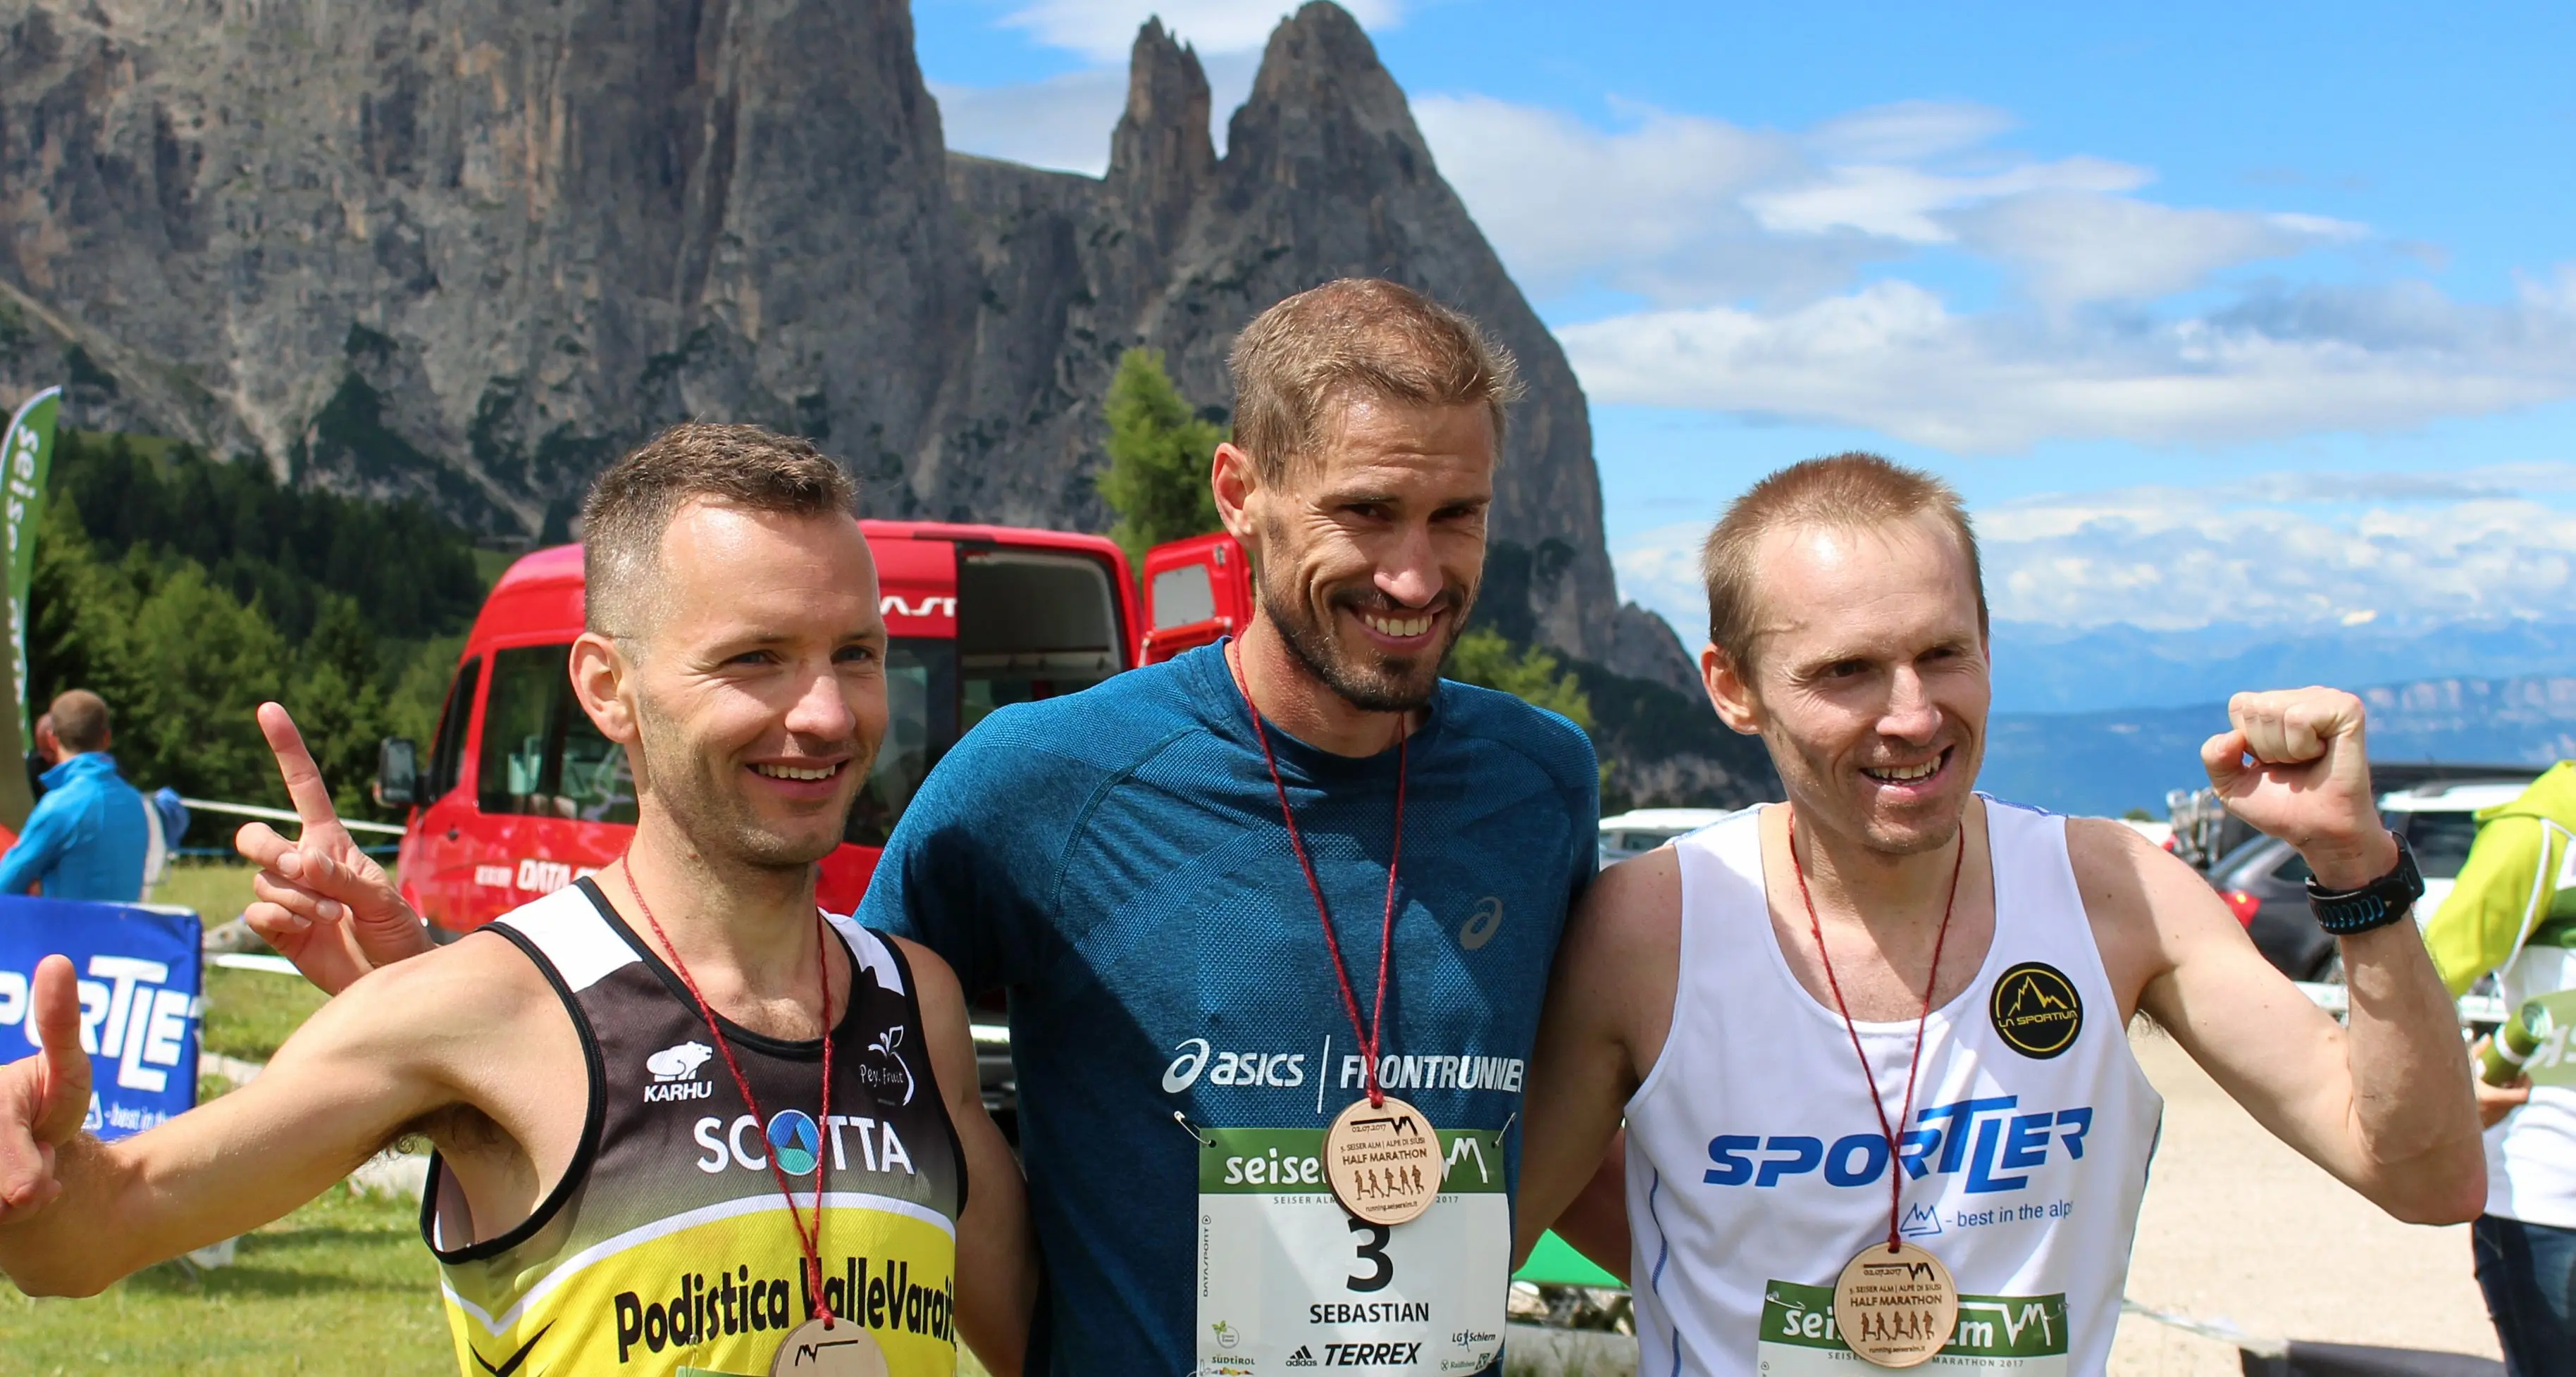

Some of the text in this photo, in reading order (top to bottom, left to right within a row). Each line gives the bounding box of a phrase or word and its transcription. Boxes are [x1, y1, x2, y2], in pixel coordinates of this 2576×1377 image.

[0, 955, 203, 1092] PRTLE
[1998, 1010, 2078, 1028] LA SPORTIVA
[1340, 1055, 1524, 1093] FRONTRUNNER
[644, 1080, 712, 1102] KARHU
[694, 1109, 915, 1176] SCOTTA
[1346, 1142, 1367, 1152] SEISER
[1368, 1141, 1381, 1149] ALM
[1386, 1139, 1401, 1147] ALPE
[1702, 1095, 2093, 1194] SPORTLER
[1342, 1148, 1428, 1165] HALF MARATHON
[1957, 1209, 1994, 1227] best
[1999, 1206, 2013, 1223] in
[2019, 1203, 2043, 1221] the
[1346, 1216, 1394, 1292] 3
[614, 1257, 957, 1364] Podistica ValleVarait
[1850, 1294, 1943, 1307] HALF MARATHON
[1310, 1302, 1429, 1324] SEBASTIAN
[1452, 1331, 1496, 1342] LG Schlern
[1286, 1358, 1318, 1366] adidas
[1325, 1342, 1422, 1366] TERREX
[1828, 1352, 1862, 1361] SEISE
[1932, 1357, 1995, 1367] MARATHON
